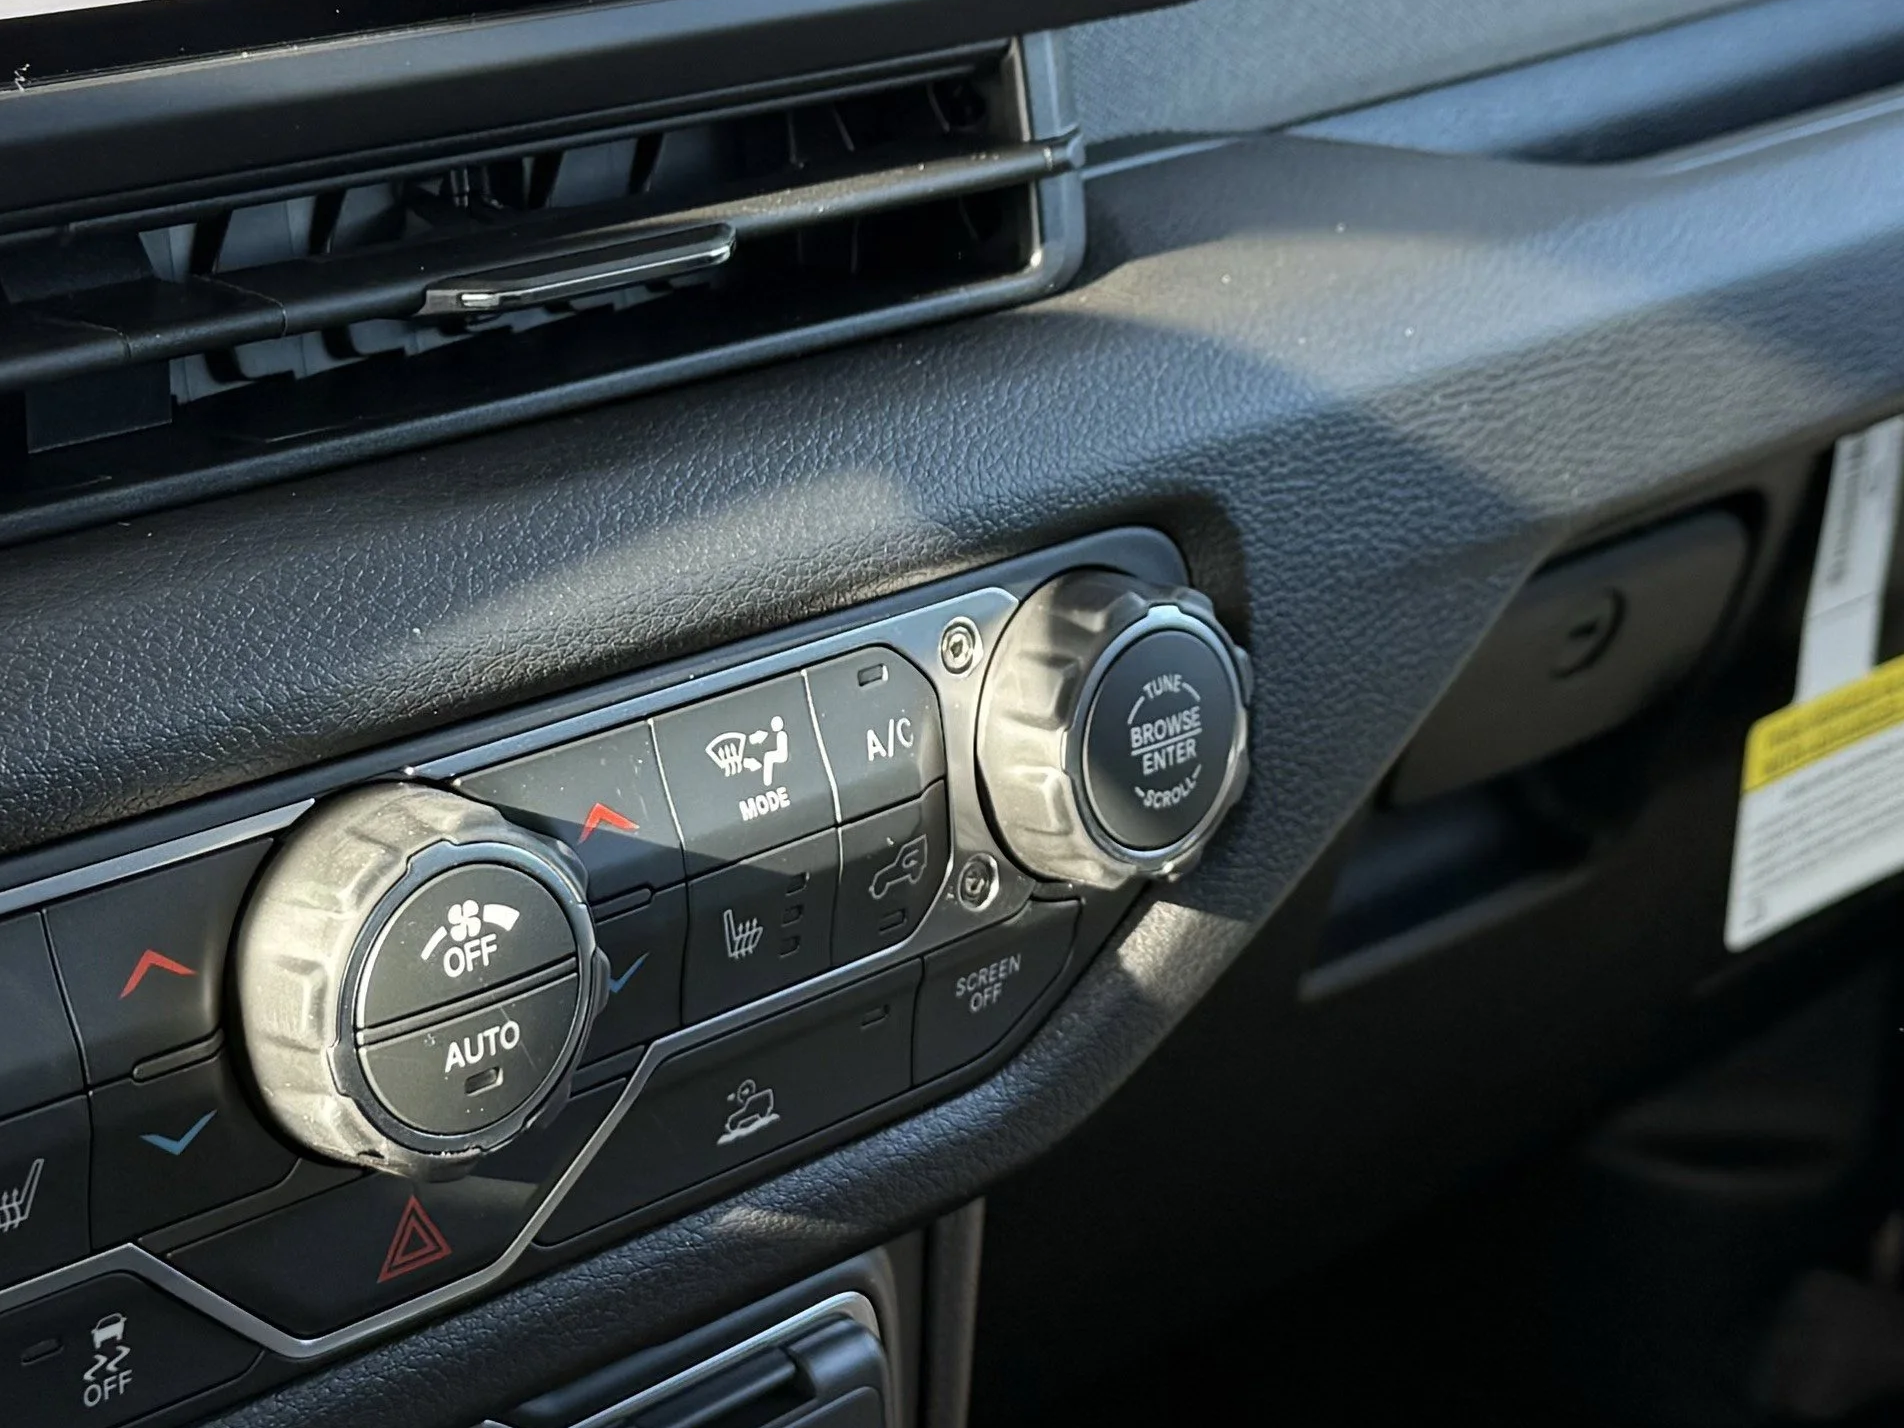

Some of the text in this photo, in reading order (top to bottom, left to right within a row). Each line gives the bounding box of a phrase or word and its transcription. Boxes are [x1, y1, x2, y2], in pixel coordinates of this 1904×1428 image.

[1142, 673, 1183, 701] TUNE
[864, 717, 915, 764] A/C
[1130, 705, 1202, 749] BROWSE
[1142, 737, 1198, 776] ENTER
[739, 785, 791, 823] MODE
[1142, 776, 1198, 809] SCROLL
[442, 933, 498, 979] OFF
[954, 952, 1022, 998] SCREEN
[969, 983, 1004, 1015] OFF
[443, 1020, 521, 1074] AUTO
[82, 1368, 133, 1410] OFF
